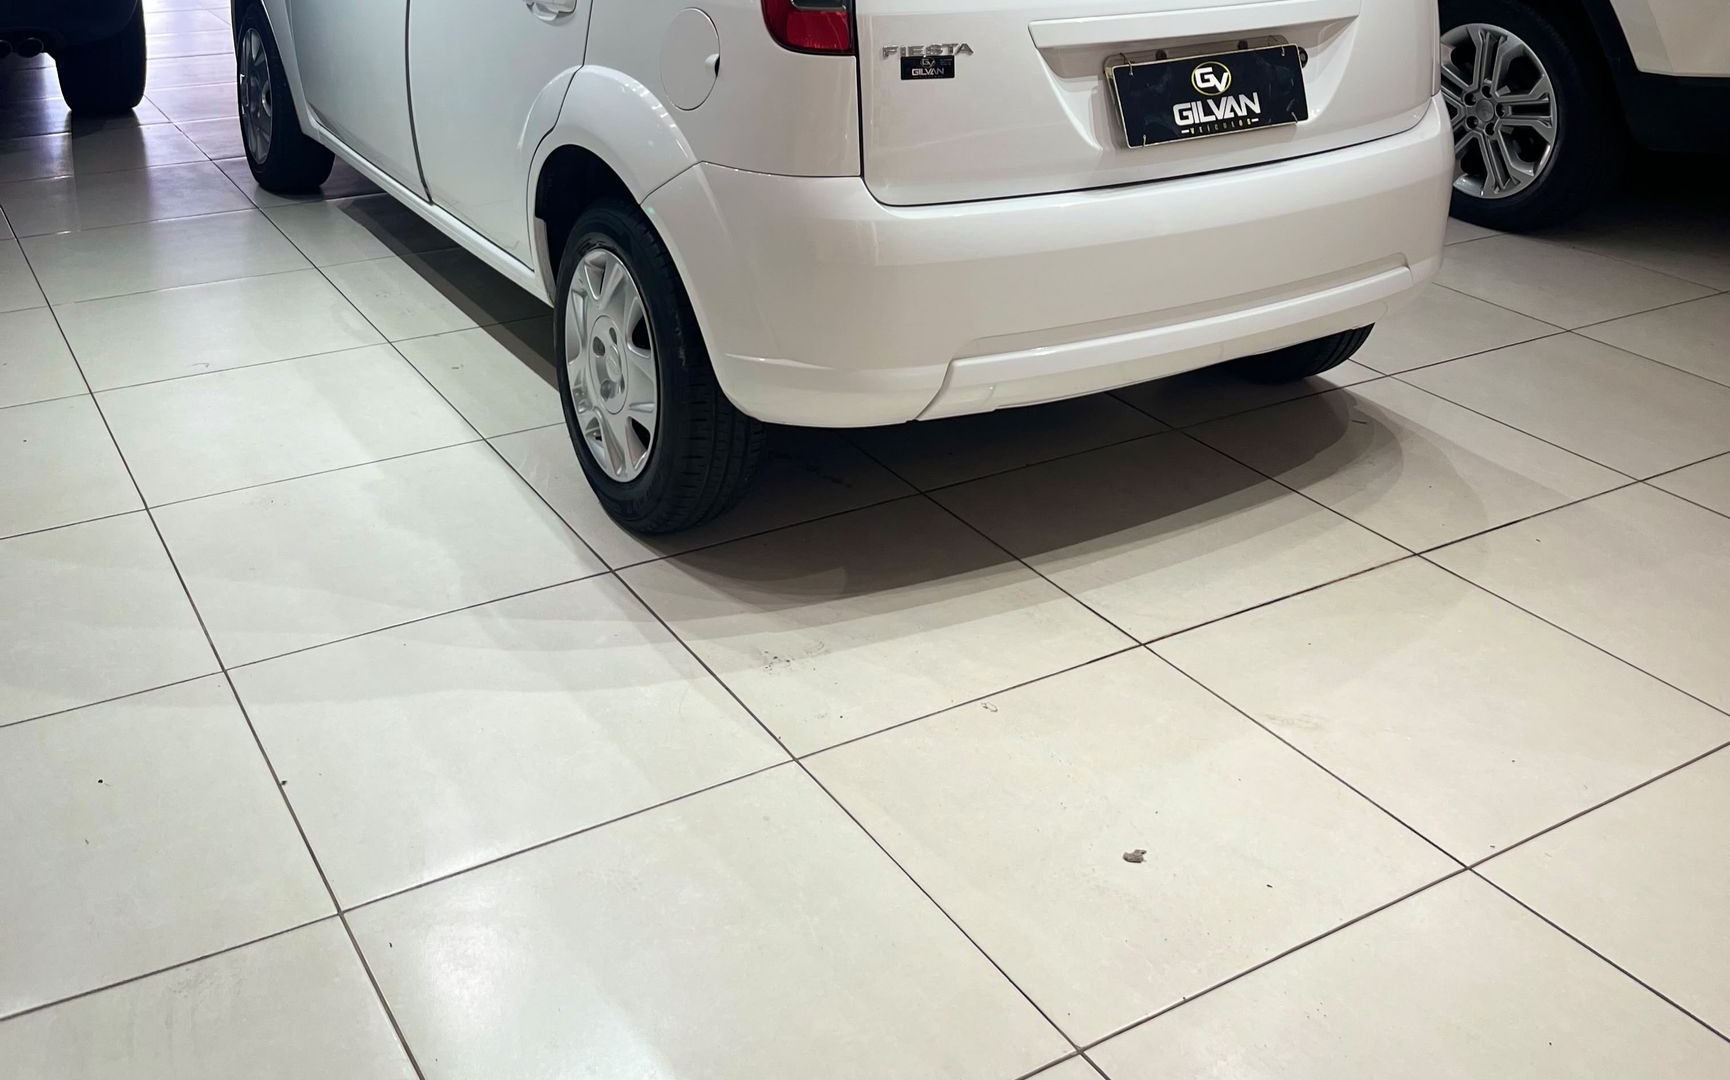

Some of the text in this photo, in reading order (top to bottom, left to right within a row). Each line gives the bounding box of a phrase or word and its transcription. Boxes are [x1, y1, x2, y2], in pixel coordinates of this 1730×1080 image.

[882, 43, 974, 59] FIESTA
[911, 67, 944, 76] GILVAN
[1194, 66, 1230, 93] GV
[1173, 92, 1261, 126] GILVAN
